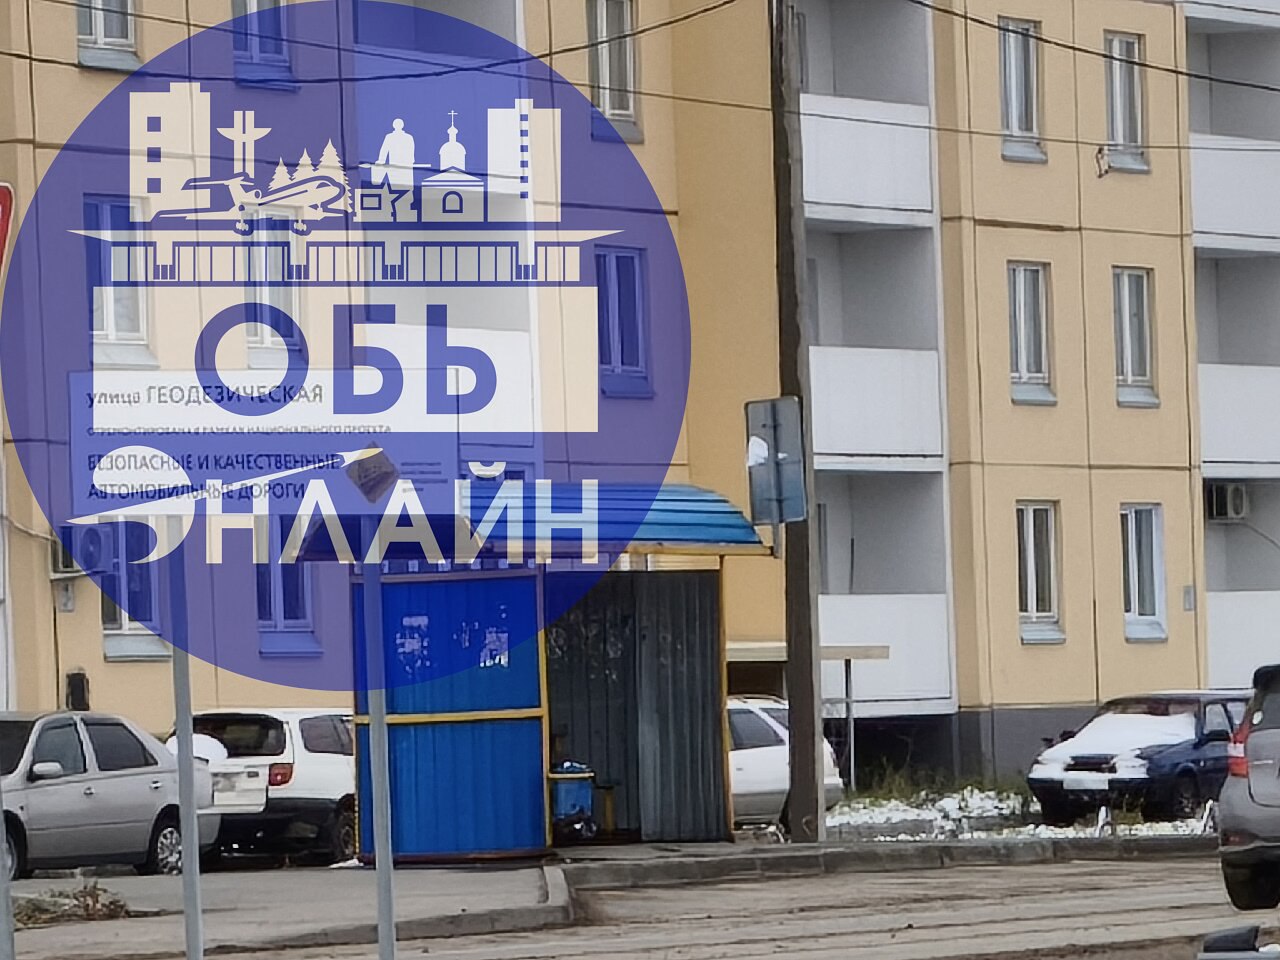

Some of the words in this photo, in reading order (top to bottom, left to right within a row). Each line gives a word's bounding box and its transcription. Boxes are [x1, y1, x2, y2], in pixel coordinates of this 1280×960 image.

[86, 391, 140, 408] улица
[146, 384, 323, 406] ГЕОДЕЗИЧЕСКАЯ
[87, 454, 193, 471] БЕЗОПАСНЫЕ
[198, 454, 209, 470] И
[213, 453, 341, 471] КАЧЕСТВЕННЫЕ
[88, 483, 233, 500] АВТОМОБИЛЬНЫЕ
[238, 482, 305, 501] ДОРОГИ
